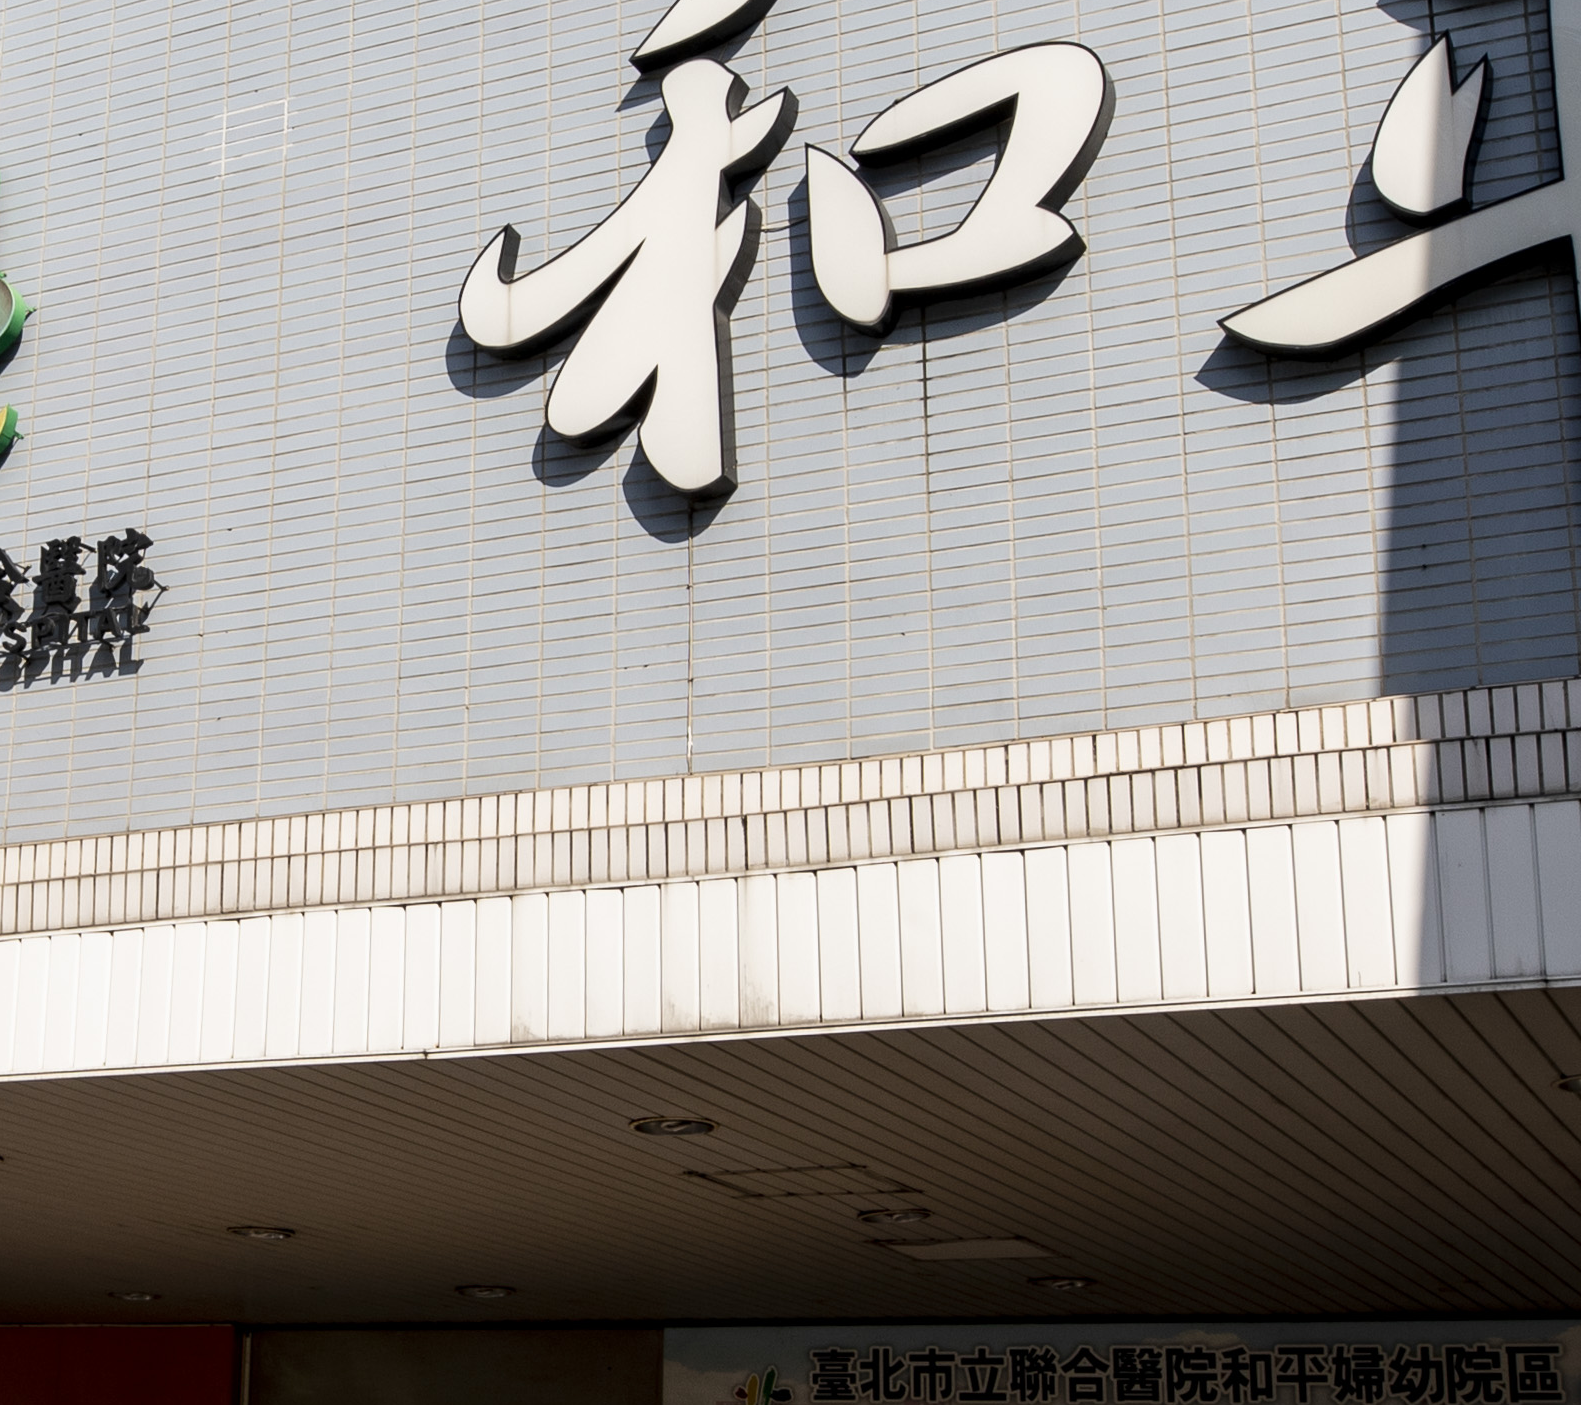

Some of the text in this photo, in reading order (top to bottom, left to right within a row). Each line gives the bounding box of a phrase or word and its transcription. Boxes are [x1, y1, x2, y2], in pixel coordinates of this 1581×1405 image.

[811, 1344, 1564, 1404] 臺北市立聯合醫院和平婦幼院區
